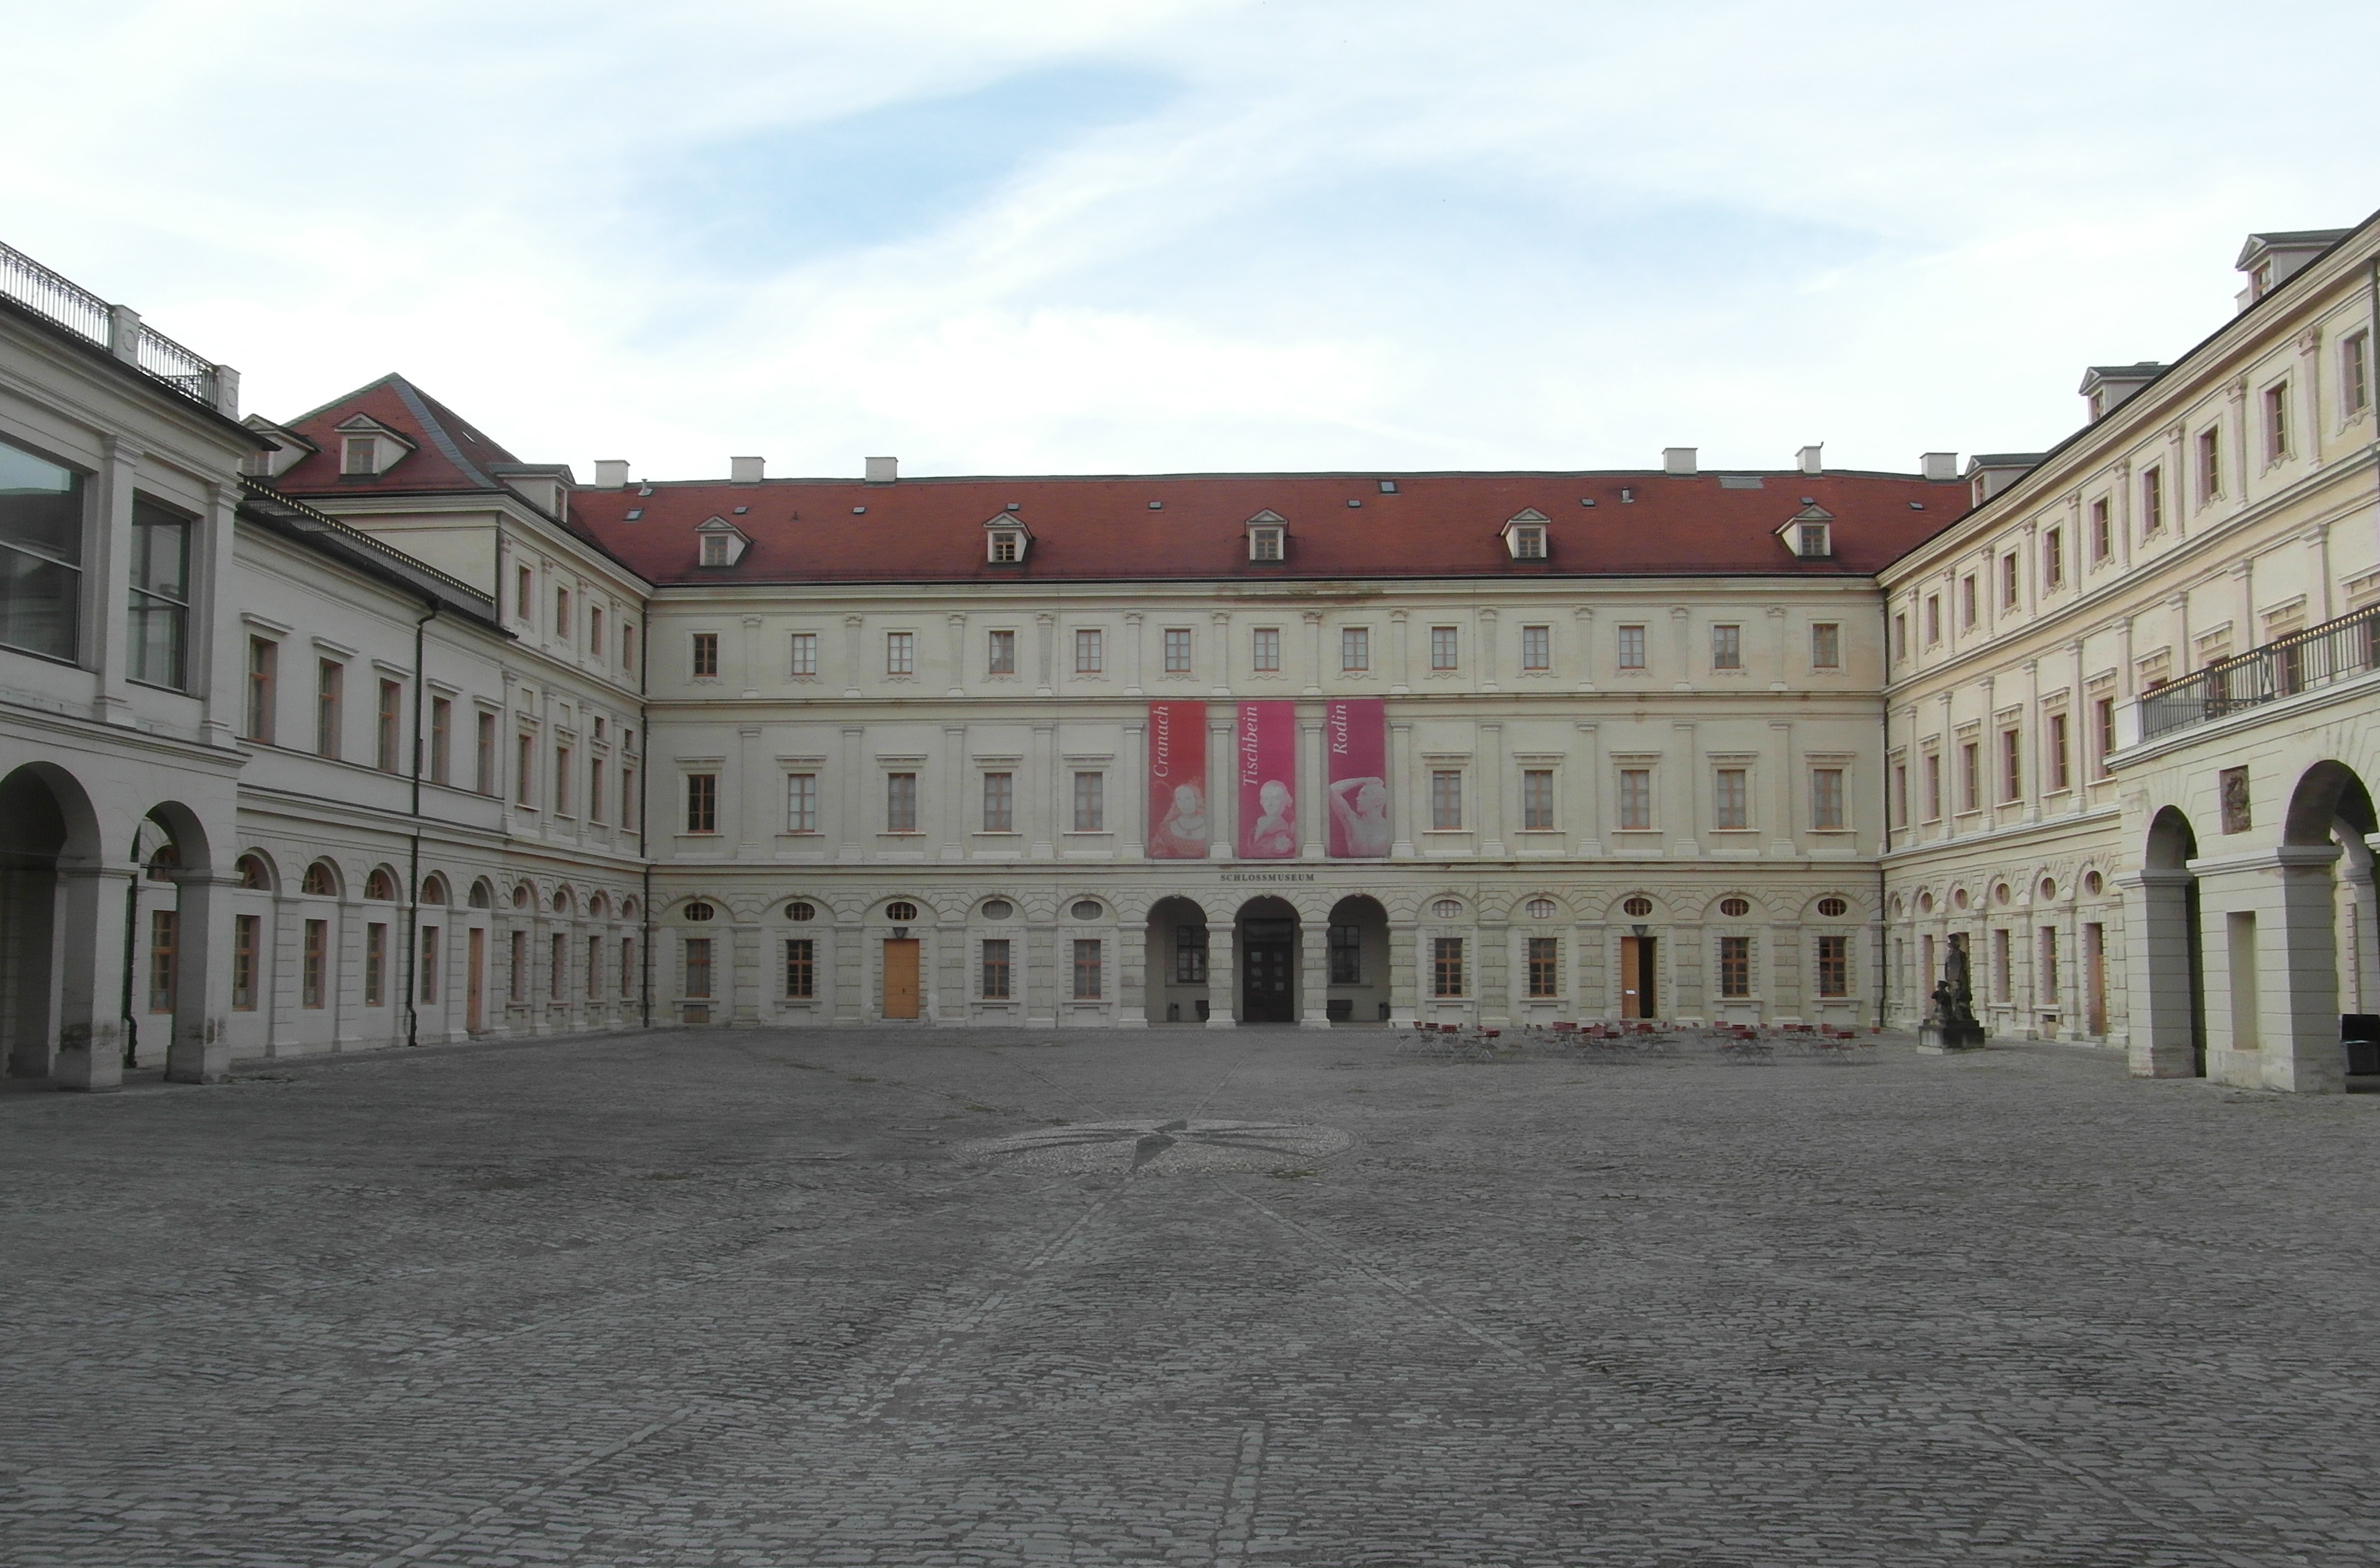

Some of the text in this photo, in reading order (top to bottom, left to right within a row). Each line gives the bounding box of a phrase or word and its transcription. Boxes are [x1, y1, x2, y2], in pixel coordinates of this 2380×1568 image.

[1153, 705, 1169, 777] Cranach
[1242, 706, 1257, 786] Tischbein
[1332, 704, 1347, 755] Rodin
